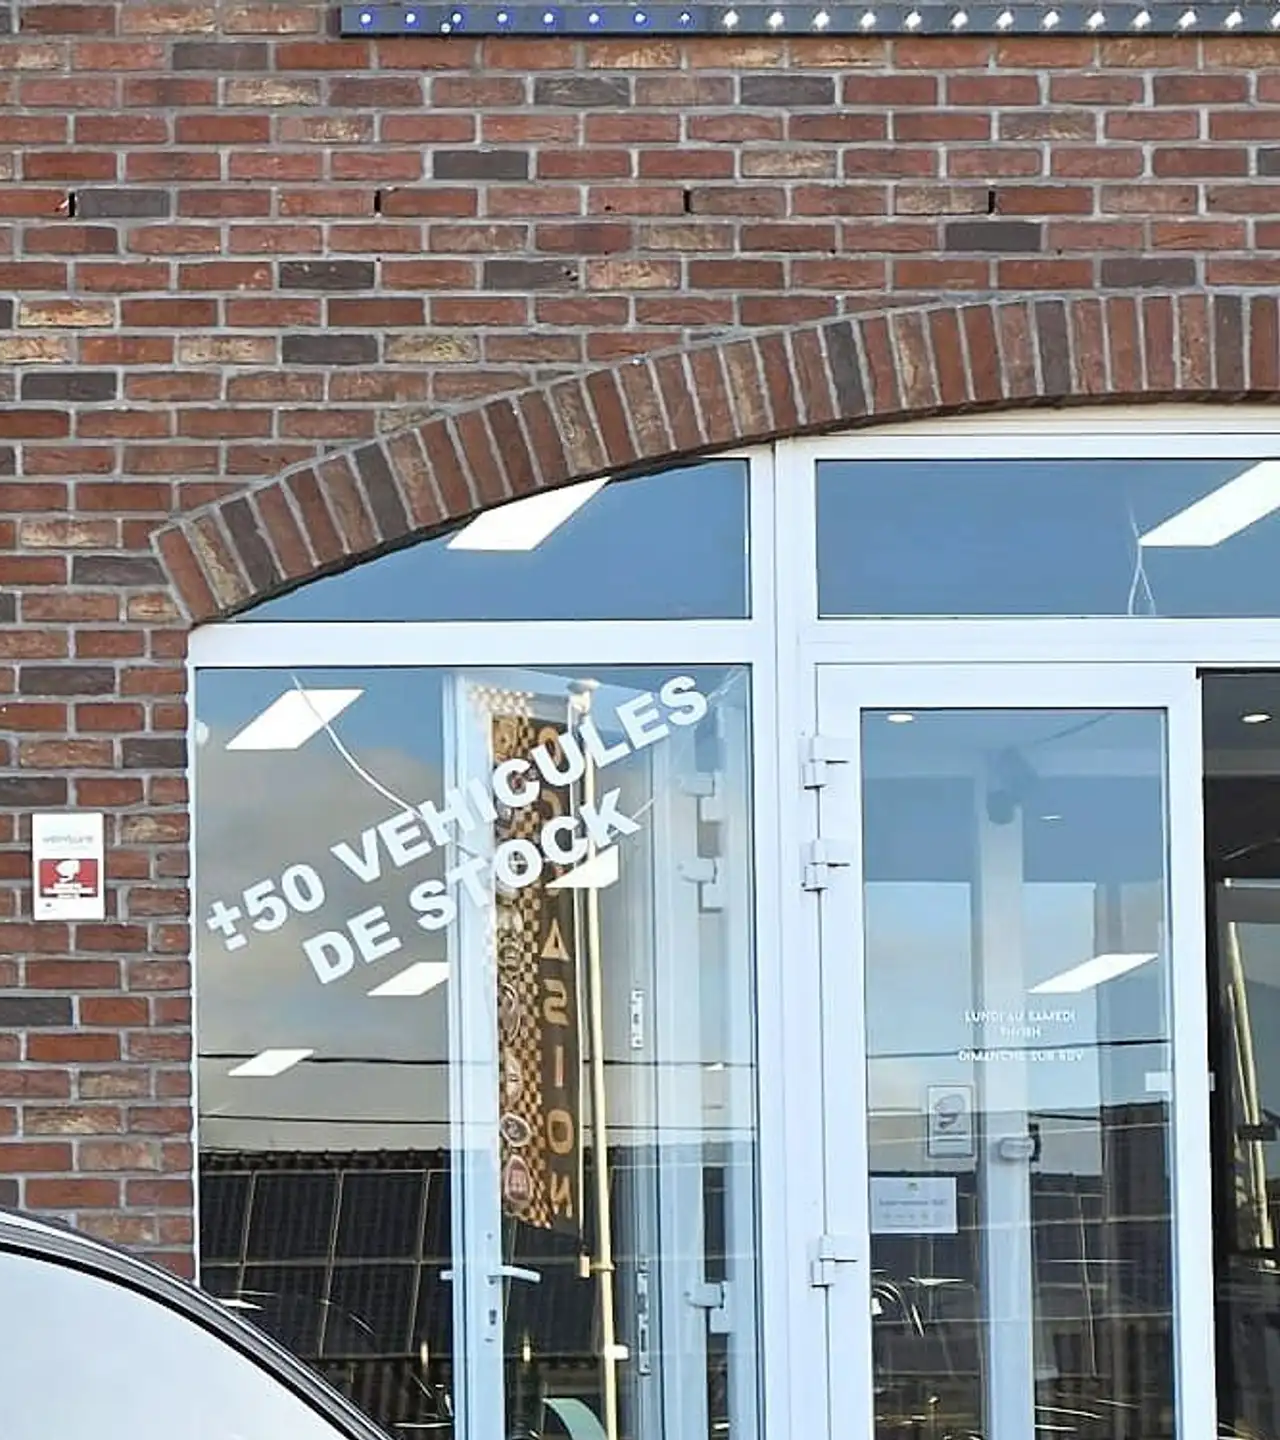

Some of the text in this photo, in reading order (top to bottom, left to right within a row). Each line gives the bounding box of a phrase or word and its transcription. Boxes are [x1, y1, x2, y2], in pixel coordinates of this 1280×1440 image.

[330, 674, 707, 884] VEHICULES
[302, 787, 641, 985] DE STOCK
